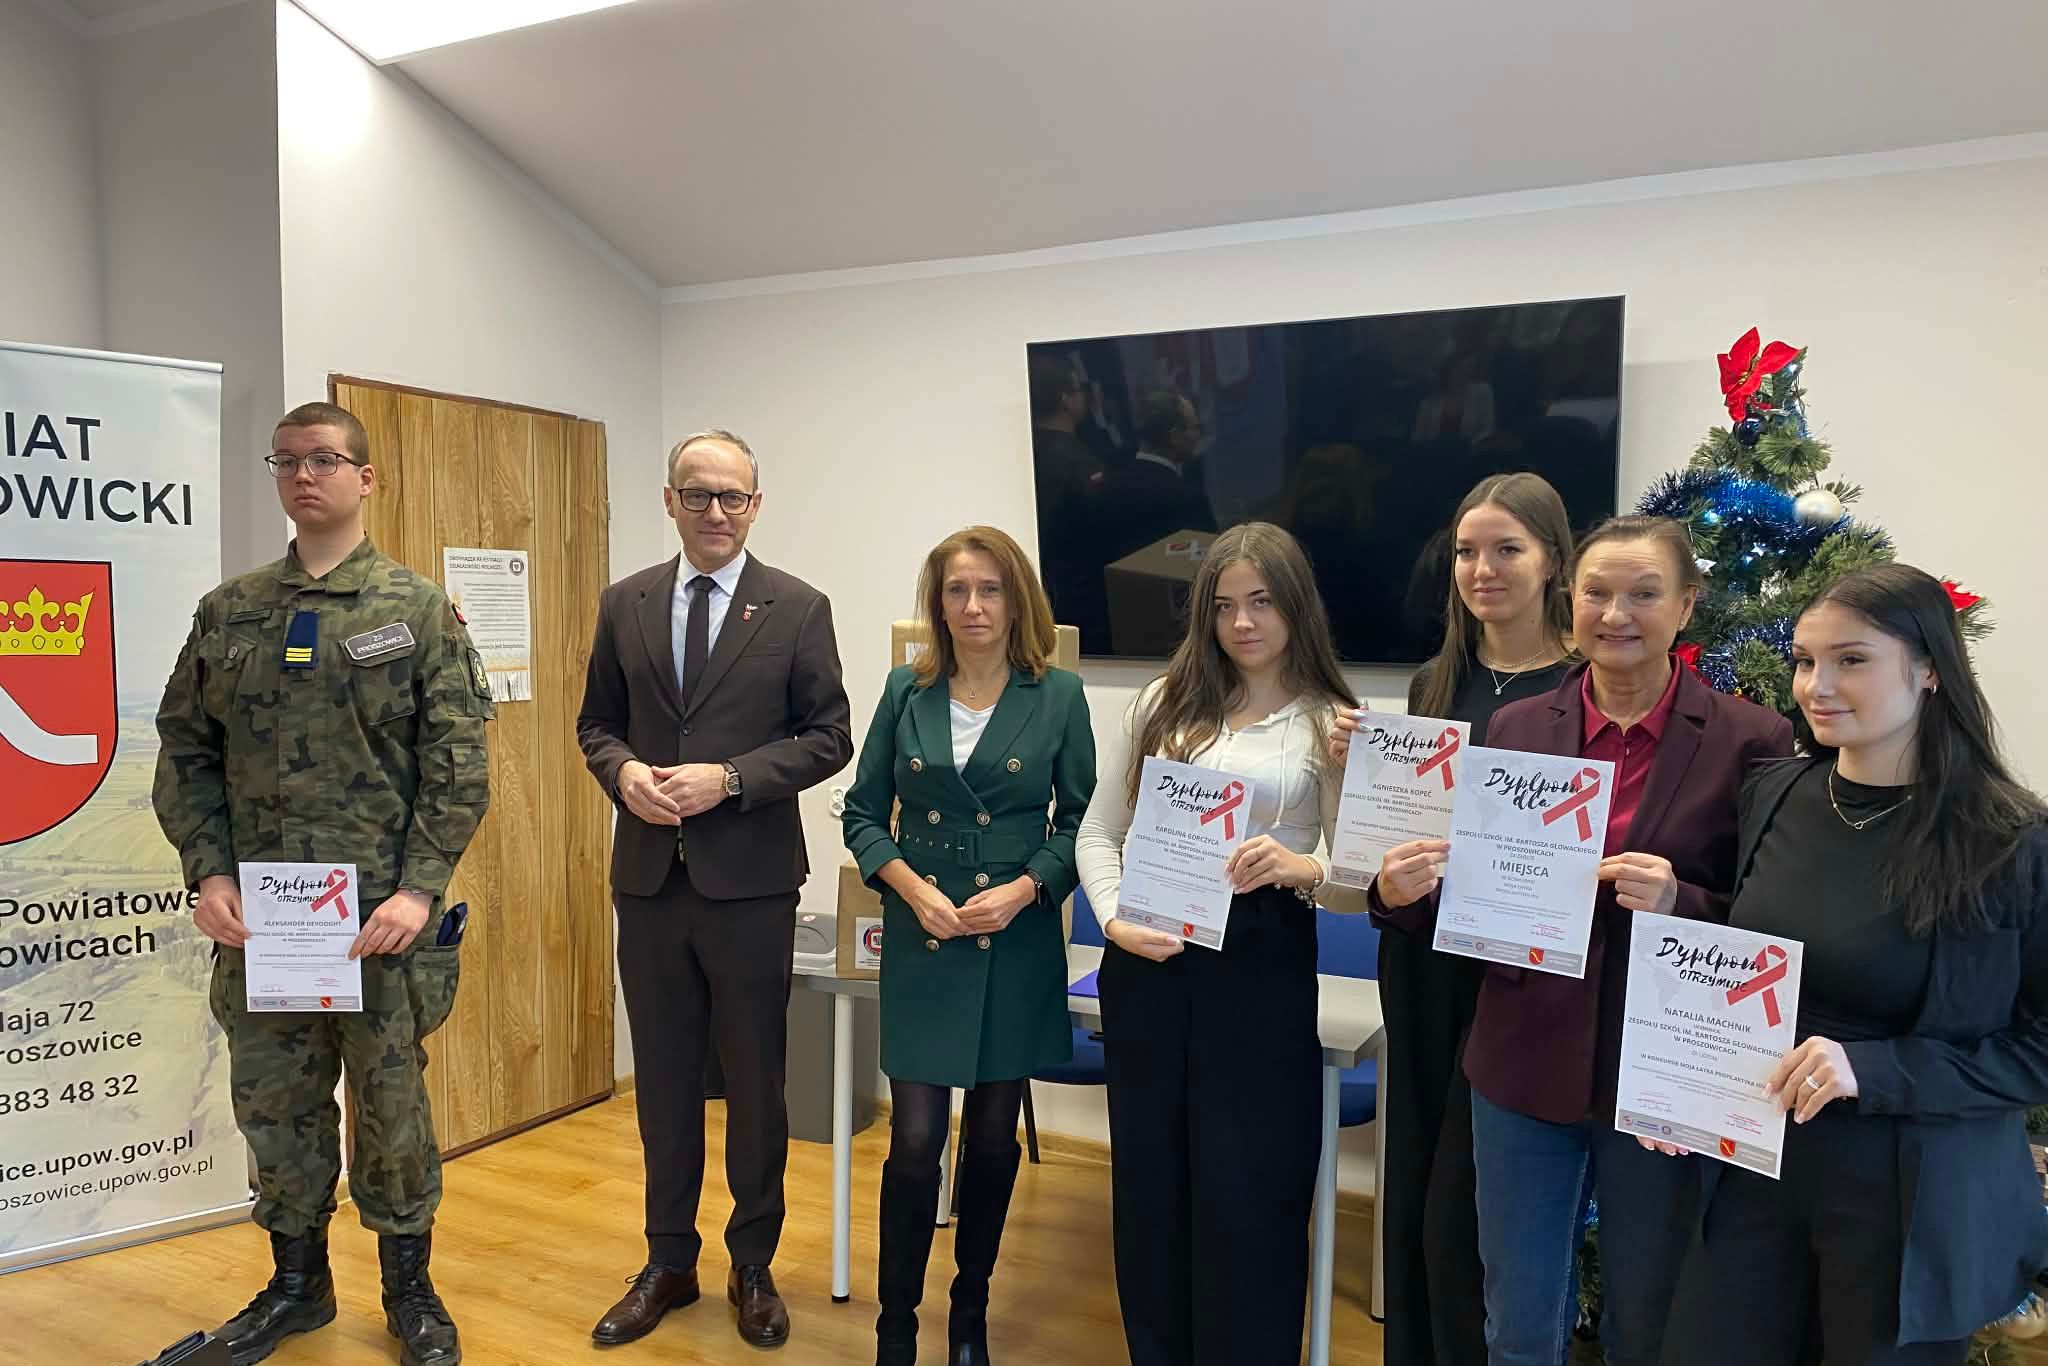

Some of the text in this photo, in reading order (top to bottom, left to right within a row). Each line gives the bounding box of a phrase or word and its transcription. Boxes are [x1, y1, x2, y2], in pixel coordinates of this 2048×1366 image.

[1513, 789, 1551, 810] dla
[1492, 859, 1550, 878] I MIEJSCA
[0, 1000, 95, 1035] aja 72
[1664, 1007, 1752, 1033] NATALIA MACHNIK
[1628, 1016, 1658, 1029] ZESPOŁU
[1695, 1031, 1731, 1045] BARTOSZA
[1732, 1040, 1784, 1059] GŁOWACKIEGO
[1673, 1034, 1681, 1042] W
[1682, 1037, 1737, 1056] PROSZOWICACH
[60, 1080, 94, 1104] 48
[104, 1074, 139, 1098] 32
